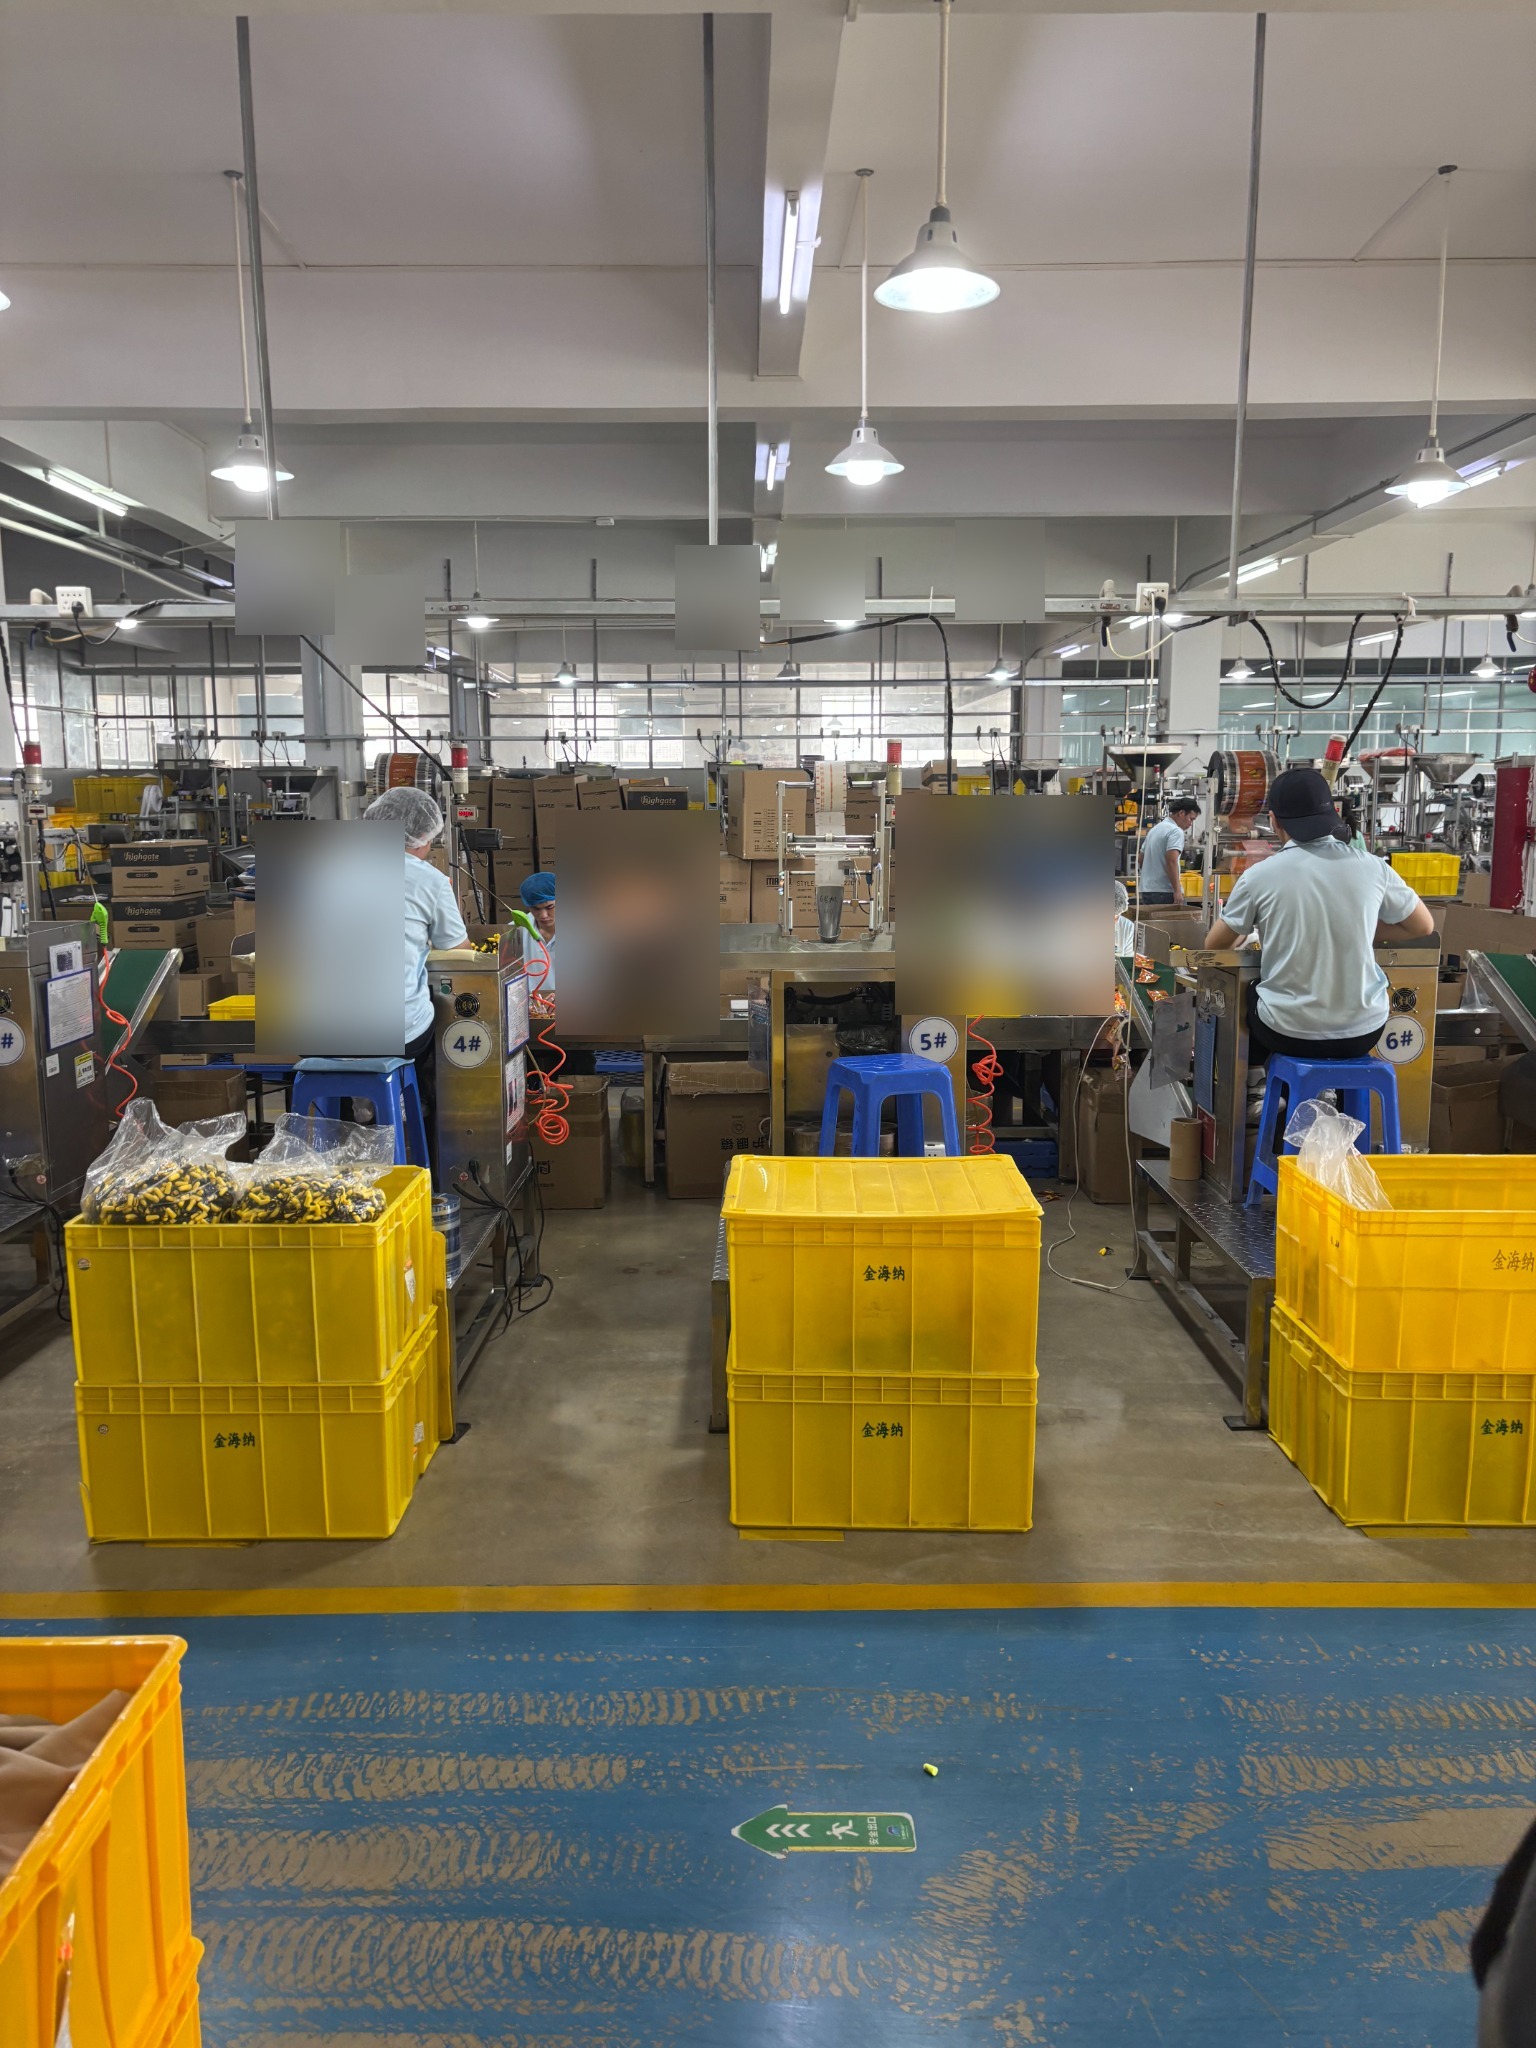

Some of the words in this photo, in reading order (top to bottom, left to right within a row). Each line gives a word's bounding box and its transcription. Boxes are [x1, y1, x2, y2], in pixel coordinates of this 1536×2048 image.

[640, 795, 677, 805] highgate
[124, 851, 160, 861] highgate
[125, 905, 161, 916] highgate
[453, 1035, 481, 1052] 4#
[920, 1032, 947, 1051] 5#
[1385, 1030, 1413, 1050] 6#
[1492, 1249, 1535, 1272] 金海纳
[863, 1265, 905, 1282] 金海纳
[861, 1421, 904, 1439] 金海纳
[1481, 1419, 1523, 1435] 金海纳
[213, 1432, 256, 1449] 金海纳
[867, 1816, 880, 1846] 安全出口
